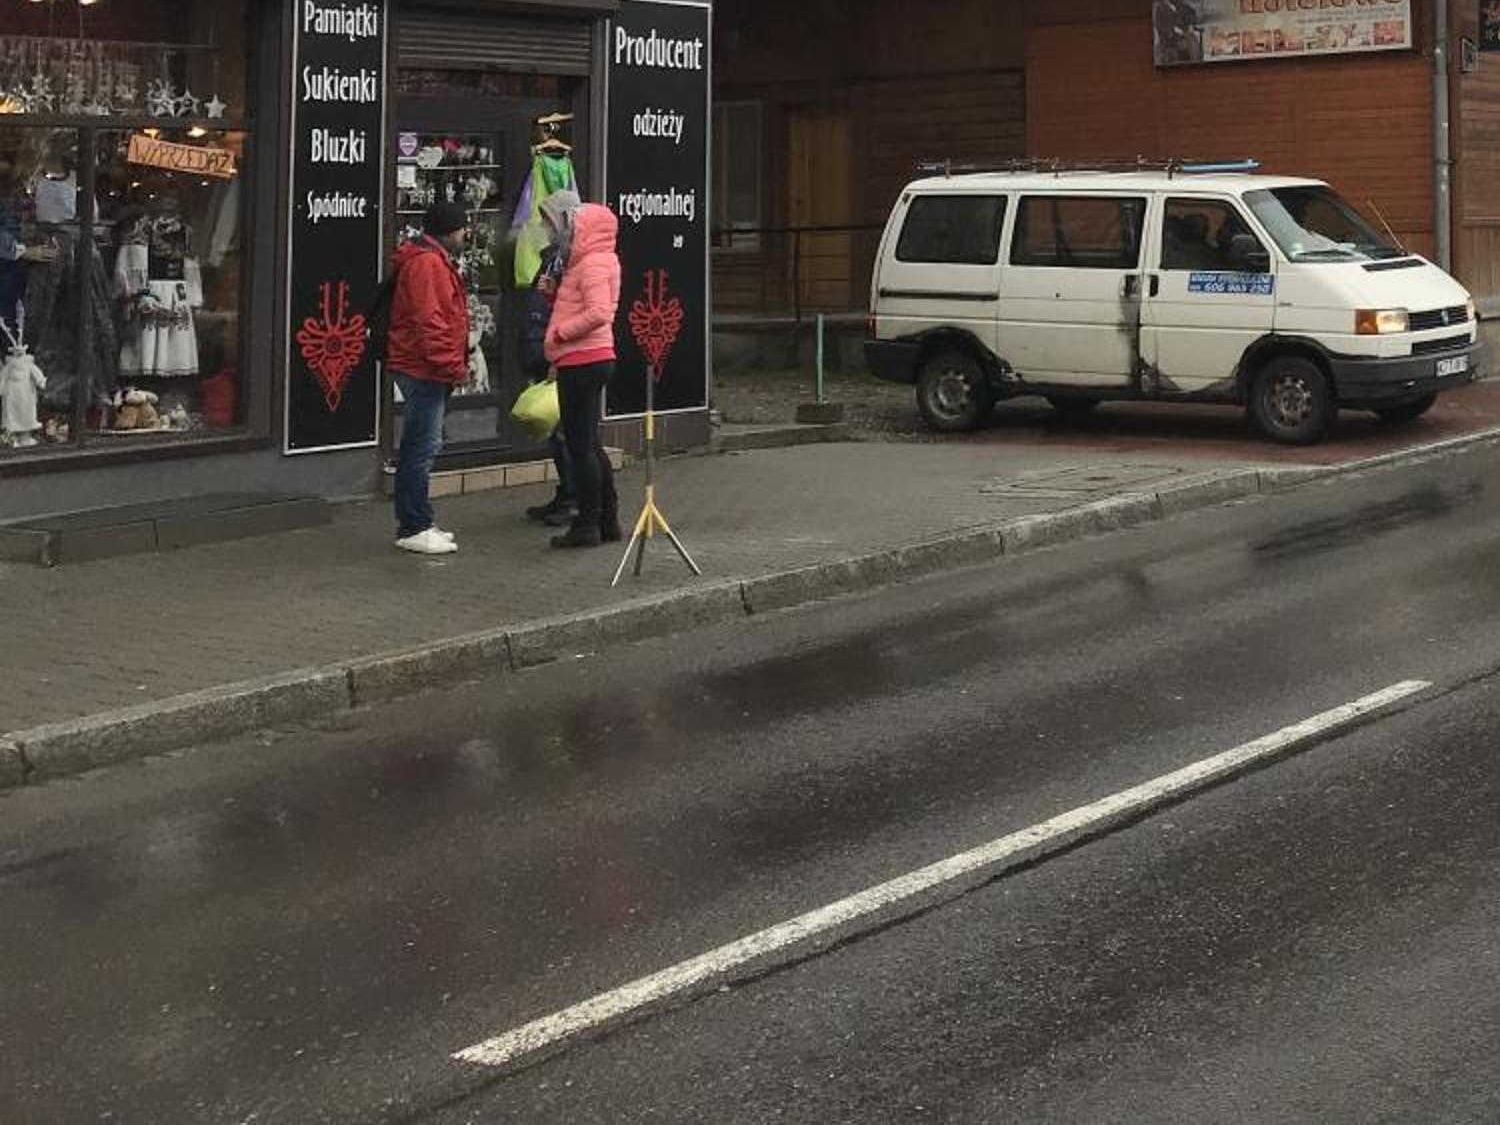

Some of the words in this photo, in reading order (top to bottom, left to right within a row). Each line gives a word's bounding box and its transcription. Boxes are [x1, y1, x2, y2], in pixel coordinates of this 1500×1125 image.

[304, 0, 378, 42] Pamiątki
[615, 26, 703, 70] Producent
[303, 65, 377, 103] Sukienki
[633, 107, 684, 145] odzieży
[311, 128, 366, 165] Bluzki
[307, 190, 367, 224] Spódnice
[619, 187, 695, 223] regionalnej
